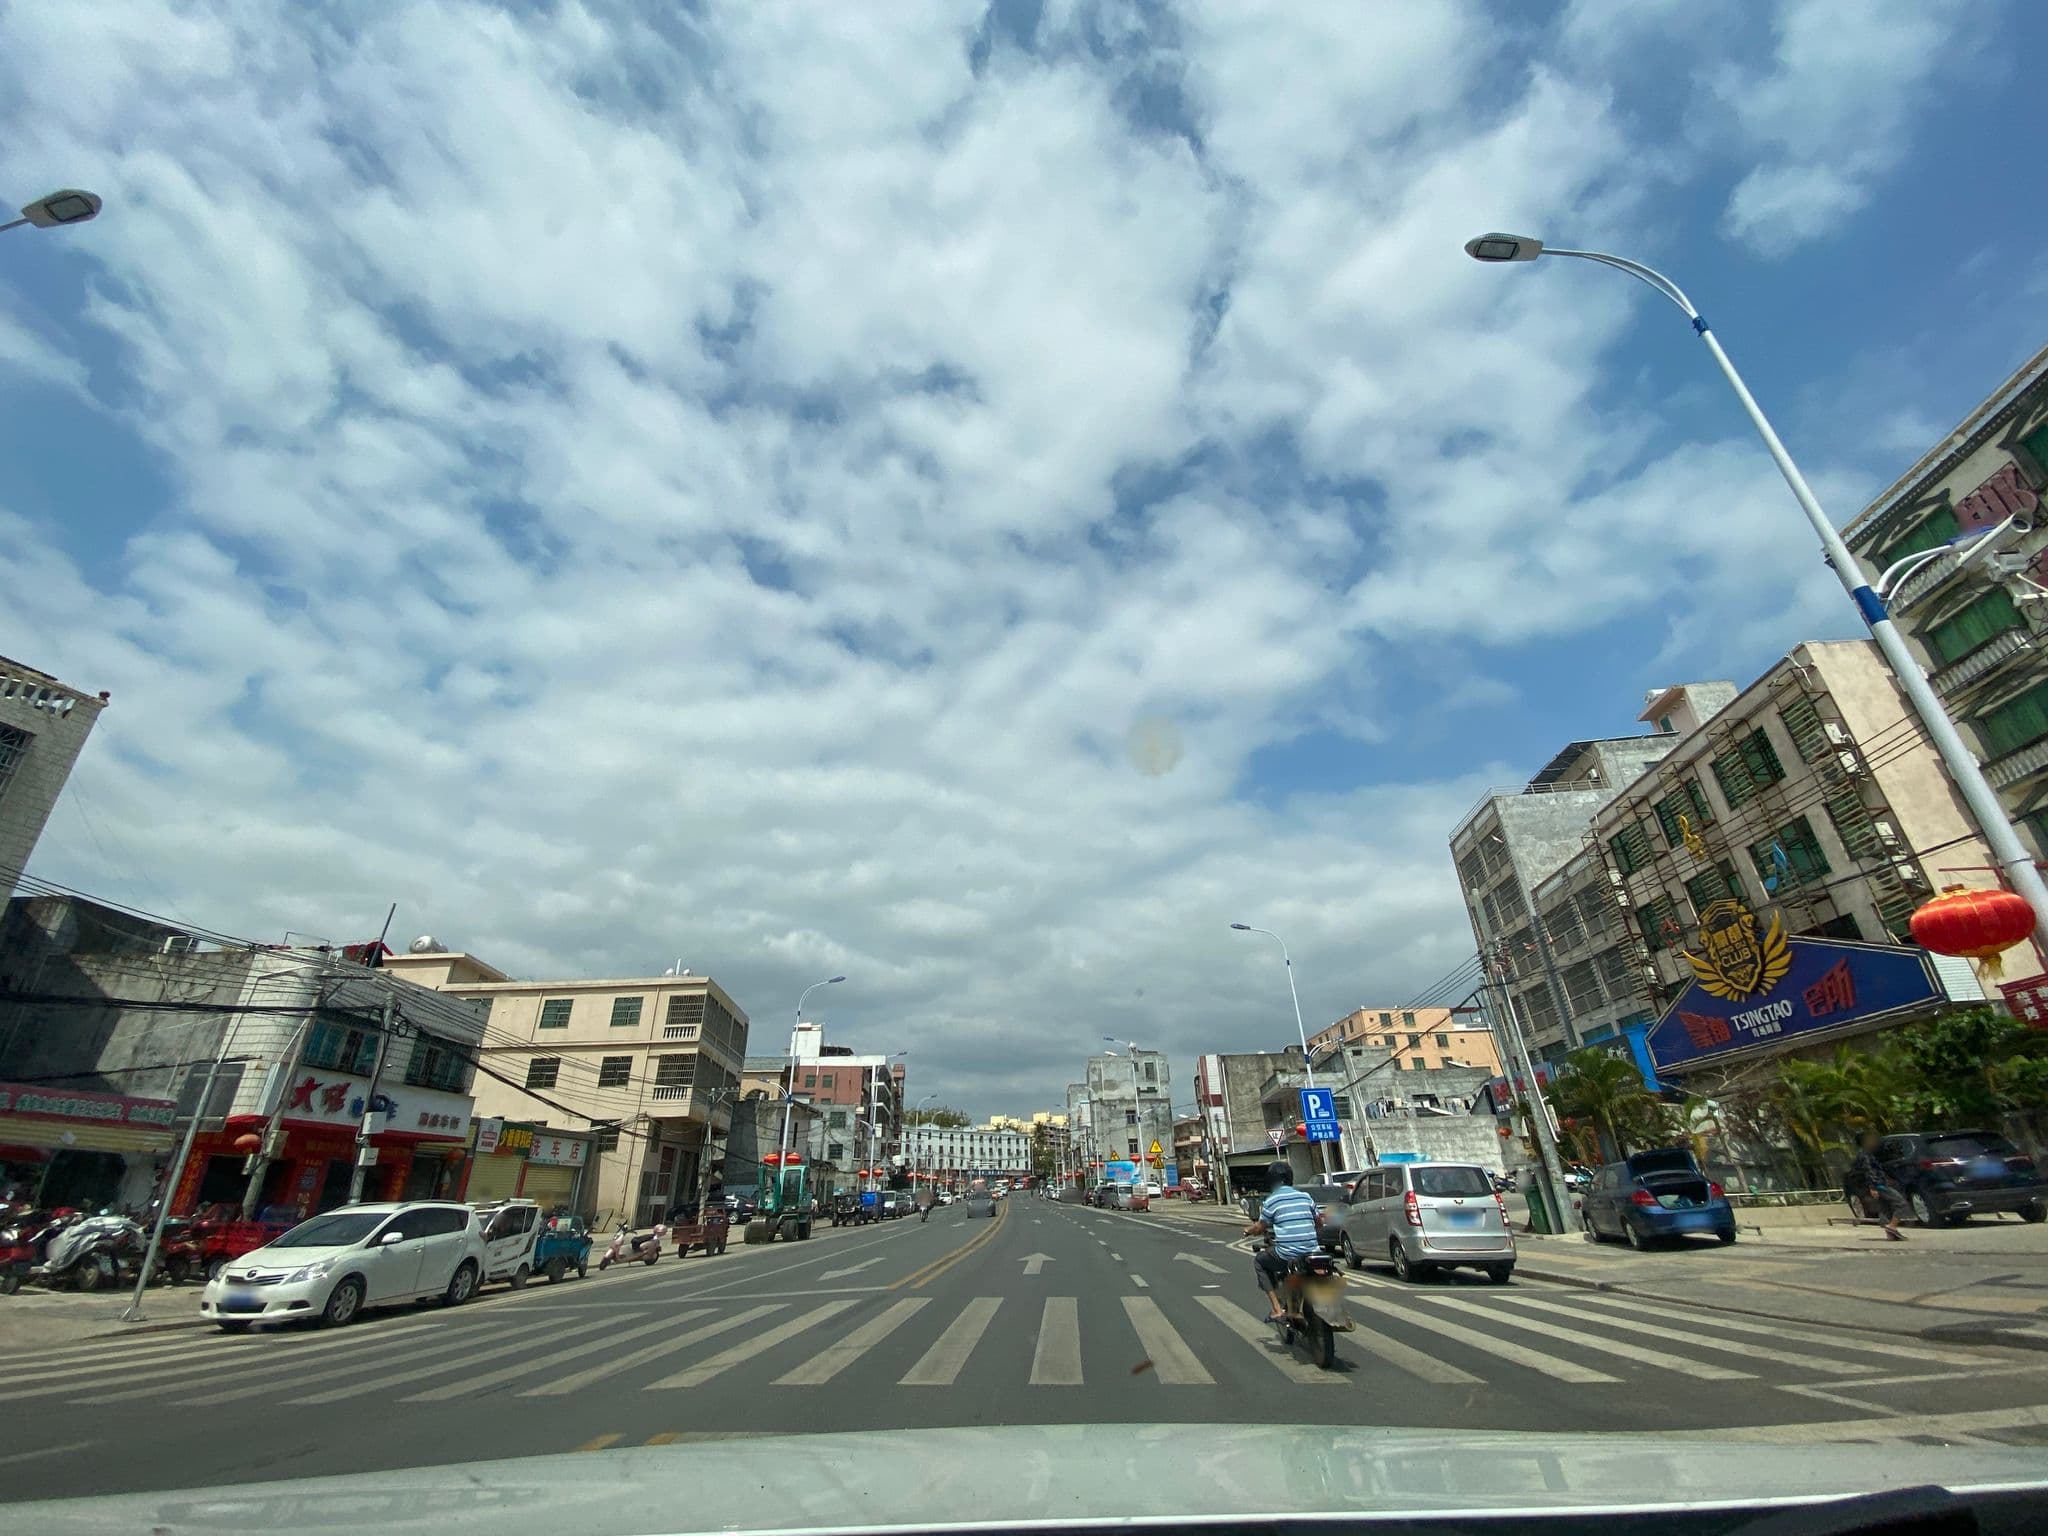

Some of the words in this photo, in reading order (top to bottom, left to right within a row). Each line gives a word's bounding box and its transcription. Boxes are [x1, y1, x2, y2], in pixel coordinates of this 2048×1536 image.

[1721, 947, 1752, 968] CLUB
[1730, 999, 1793, 1032] TSINGTAO
[1308, 1094, 1321, 1118] P
[530, 1136, 580, 1160] 洗车店
